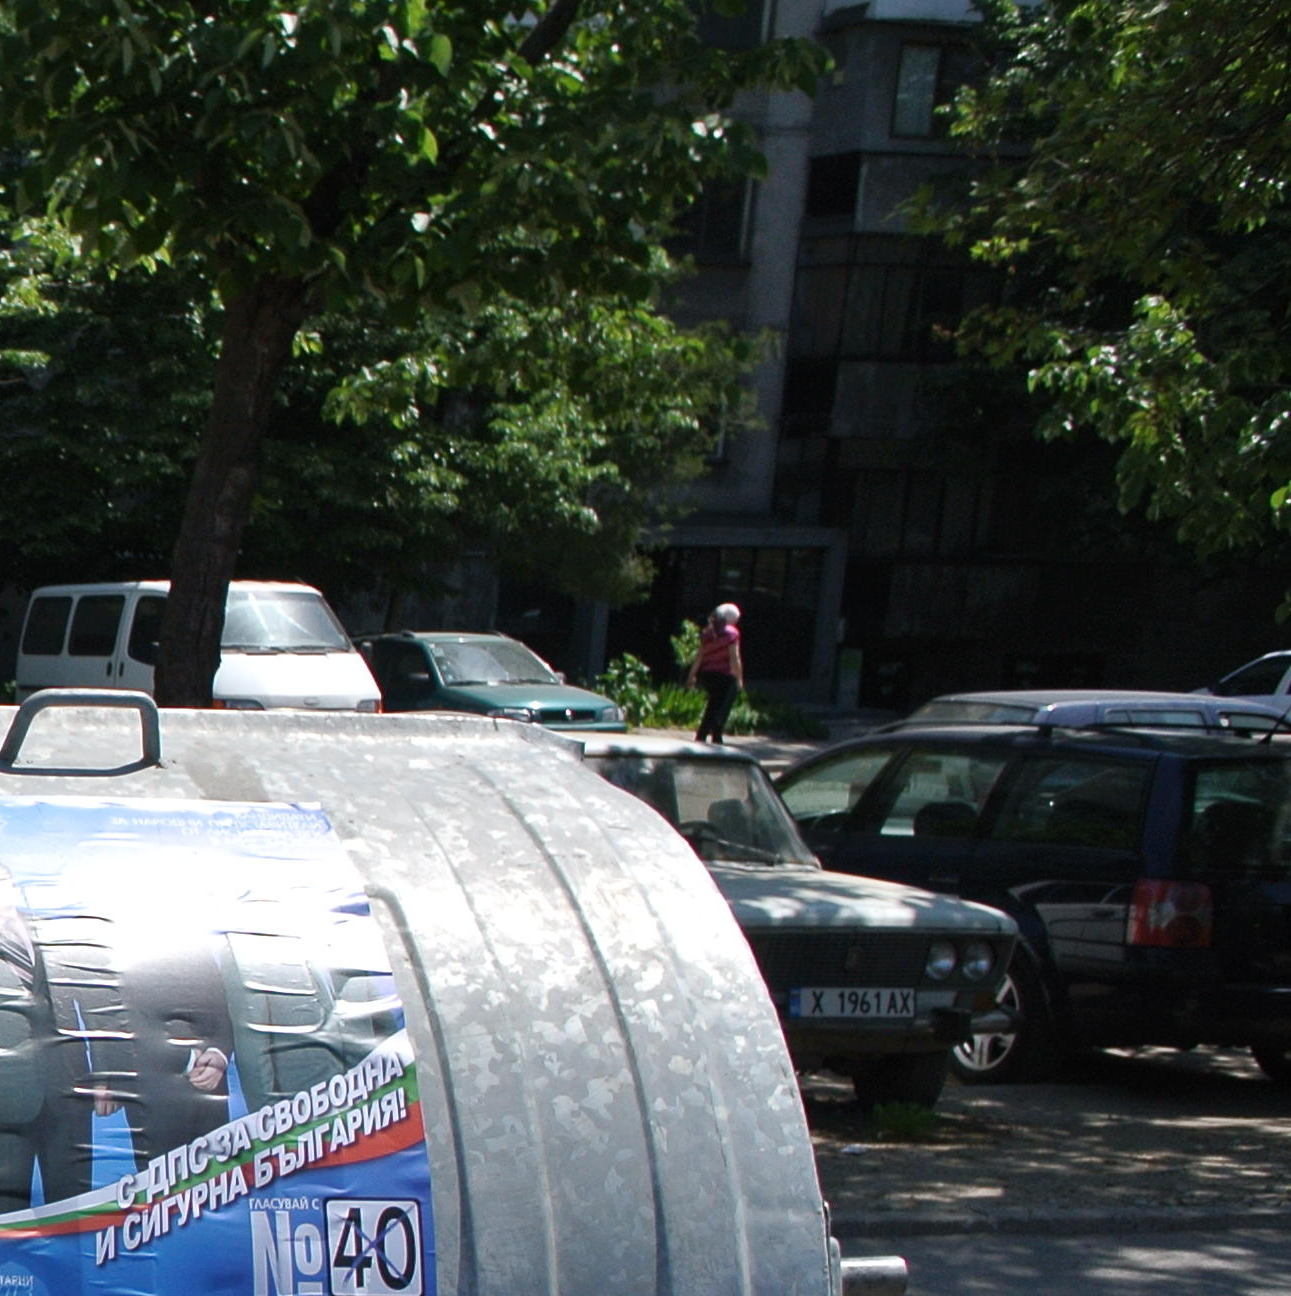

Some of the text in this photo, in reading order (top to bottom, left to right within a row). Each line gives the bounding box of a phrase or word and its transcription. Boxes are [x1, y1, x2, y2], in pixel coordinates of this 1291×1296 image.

[838, 991, 881, 1013] 1961
[886, 991, 910, 1013] AX
[116, 1052, 404, 1209] С ДПС ЗА СВОБОДНА
[96, 1086, 407, 1267] И СИГУРНА БЪЛГАРИЯ!
[249, 1196, 320, 1211] ГЛАСУВАЙ С
[332, 1206, 418, 1291] 40
